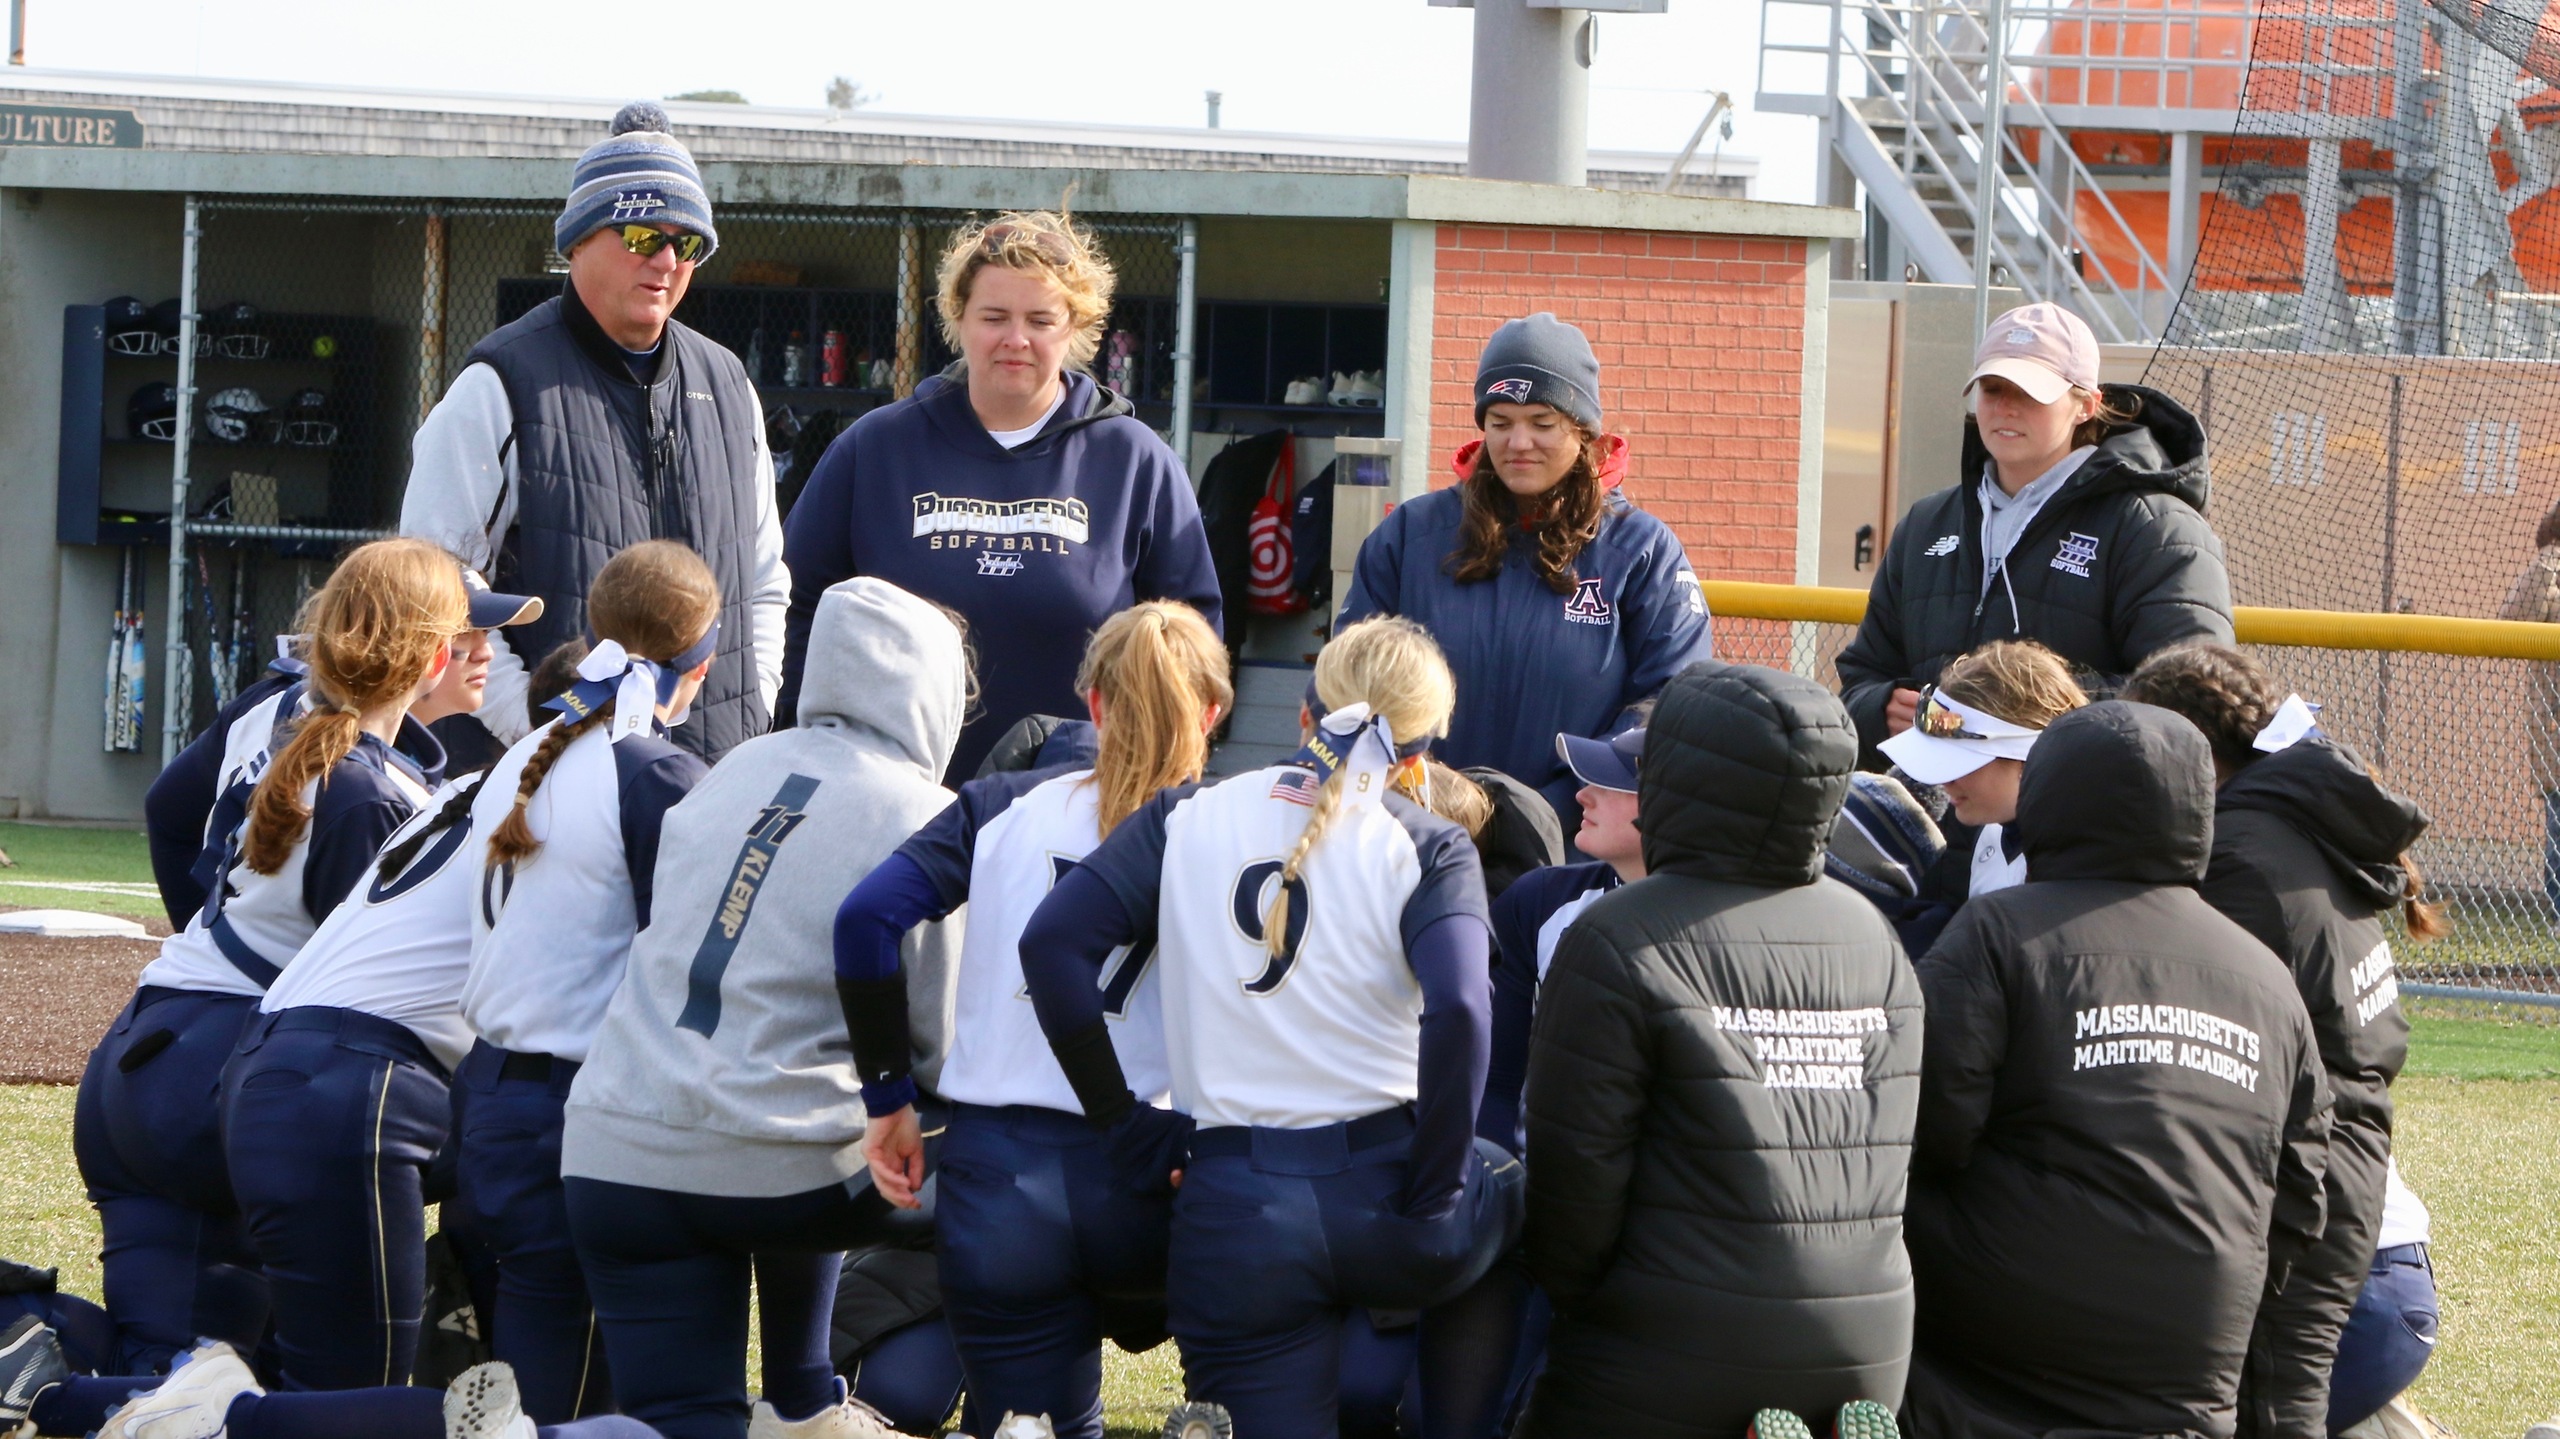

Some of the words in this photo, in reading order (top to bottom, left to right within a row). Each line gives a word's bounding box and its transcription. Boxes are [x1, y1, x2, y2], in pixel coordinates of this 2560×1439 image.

[620, 200, 659, 209] MARITIME
[912, 491, 1089, 544] BUCCANEERS
[930, 535, 1069, 555] SOFTBALL
[2050, 558, 2090, 578] SOFTBALL
[1564, 611, 1611, 625] SOFTBALL
[560, 689, 591, 717] MMA
[1307, 736, 1339, 771] MMA
[1357, 772, 1371, 793] 9
[746, 804, 807, 847] 11
[718, 847, 770, 939] KLEMP
[1228, 855, 1313, 998] 9
[1711, 1005, 1888, 1035] MASSACHUSETTS
[2074, 1004, 2260, 1063] MASSACHUSETTS
[1754, 1036, 1865, 1063] MARITIME
[1763, 1064, 1864, 1090] ACADEMY
[2073, 1039, 2174, 1072] MARITIME
[2178, 1043, 2259, 1094] ACADEMY
